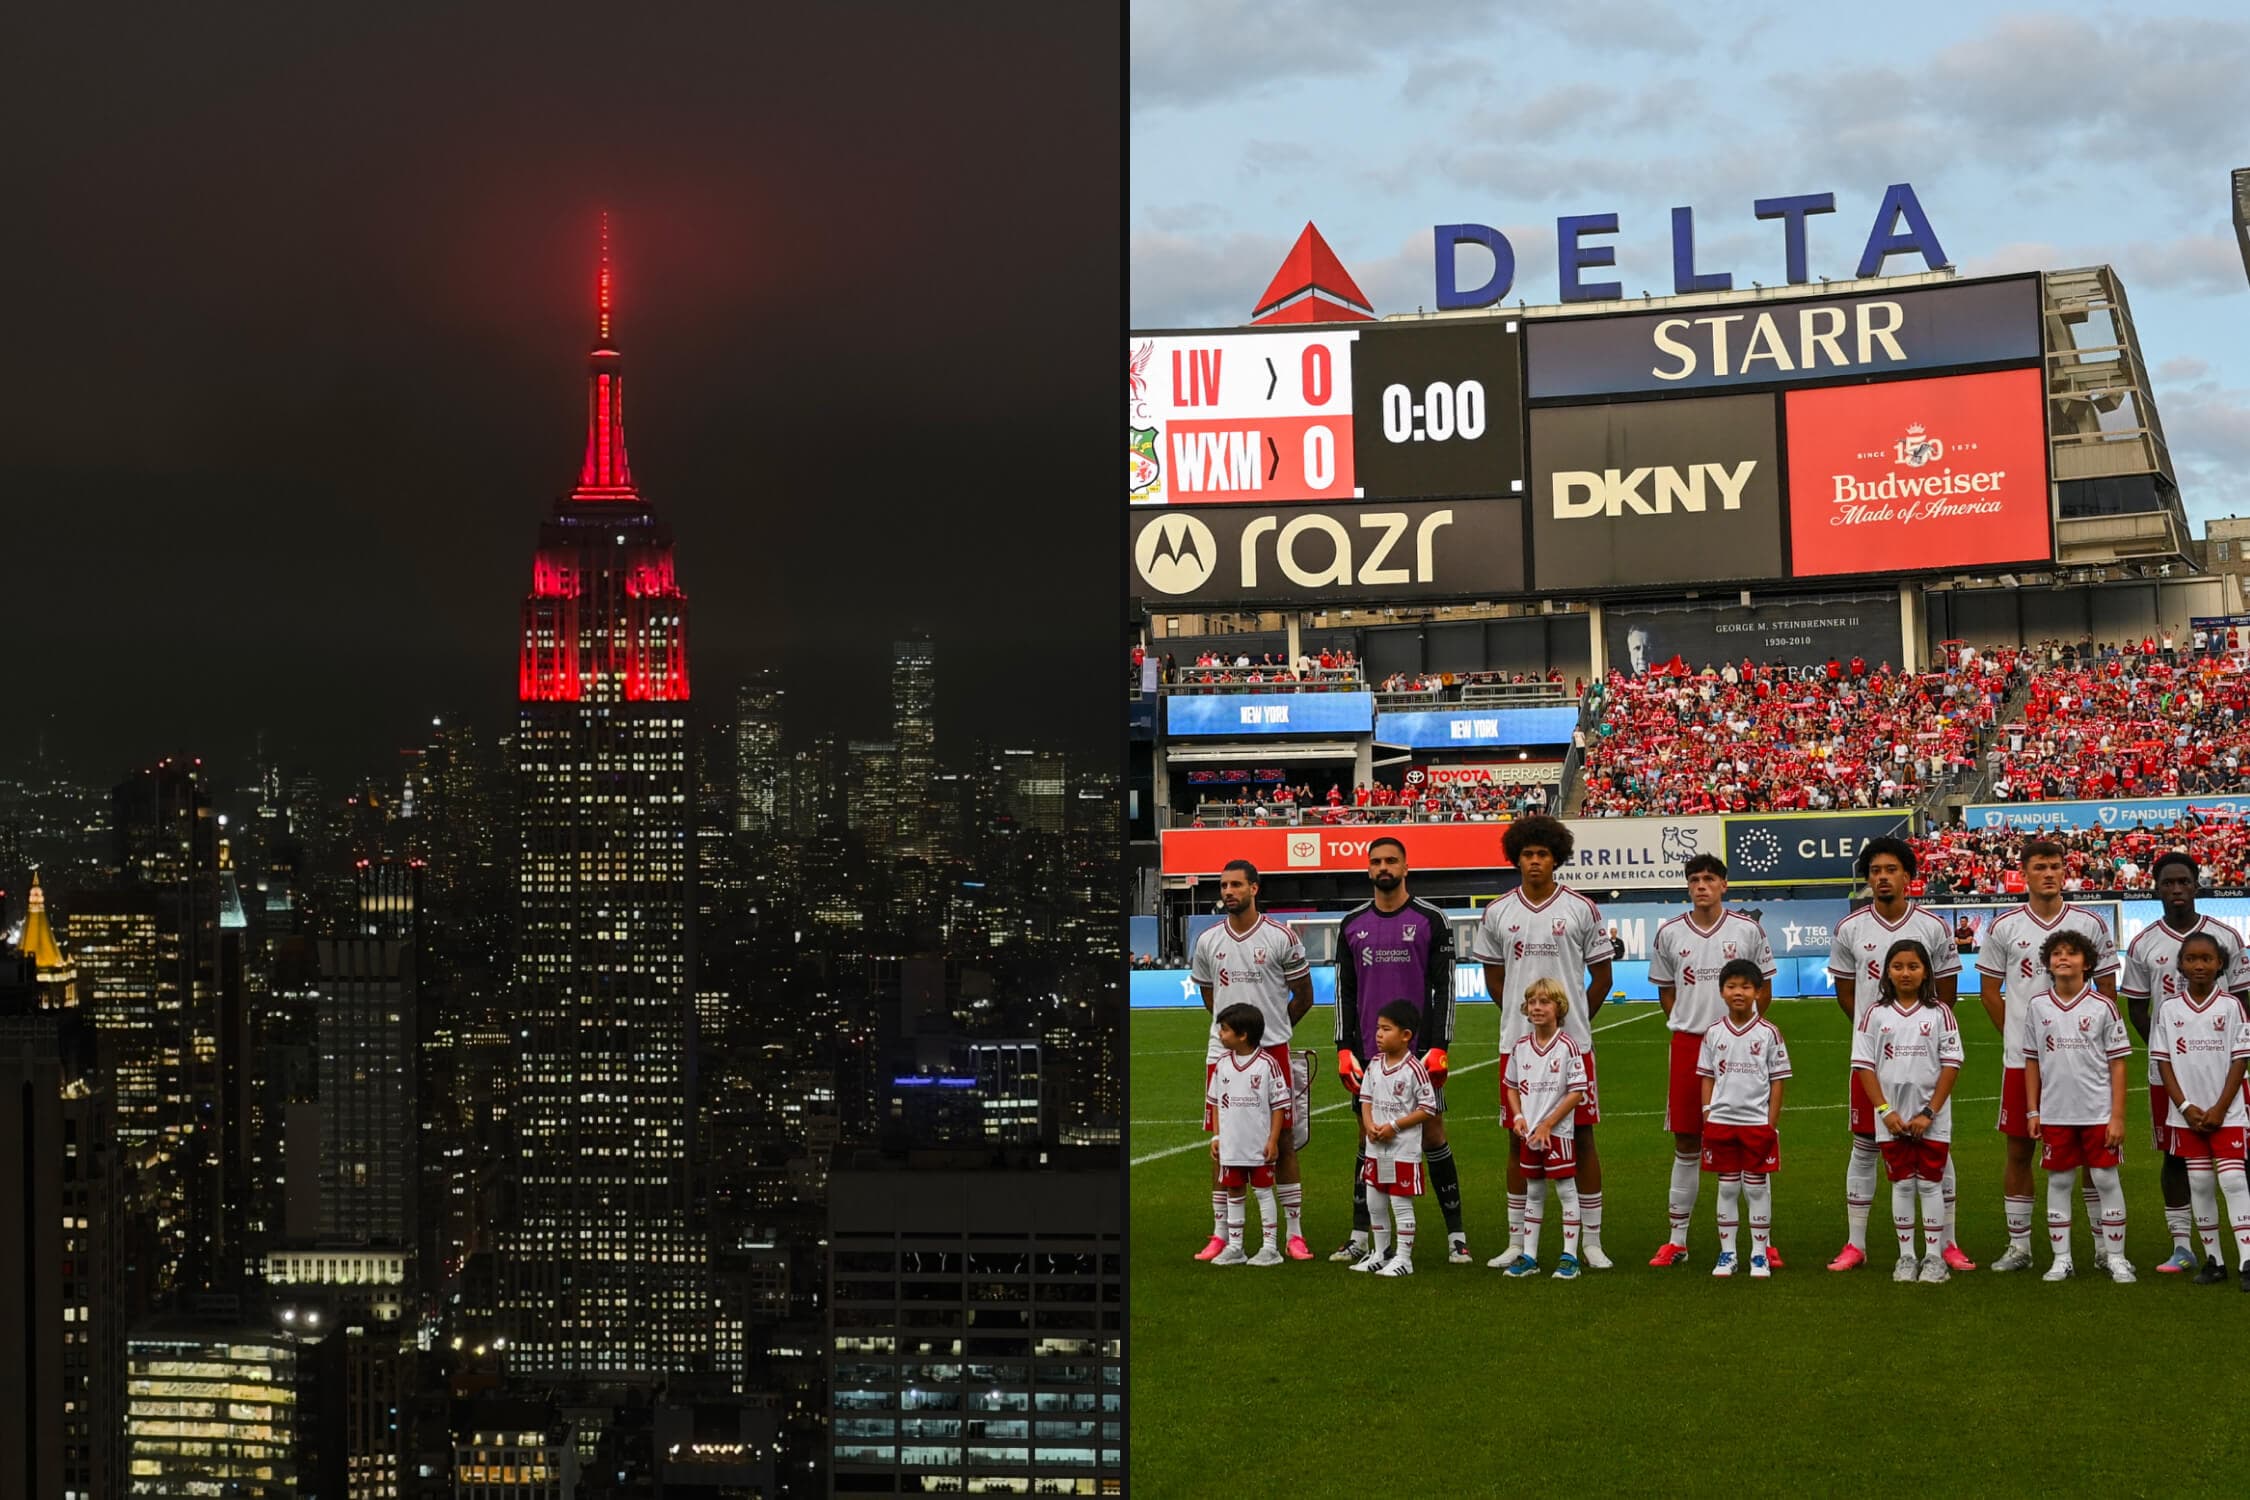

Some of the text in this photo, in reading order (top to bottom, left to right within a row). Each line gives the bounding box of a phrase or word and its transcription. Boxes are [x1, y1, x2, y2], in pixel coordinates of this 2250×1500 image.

[1434, 182, 1949, 311] DELTA
[1652, 300, 1908, 382] STARR
[1172, 344, 1333, 407] LIV 0
[1383, 379, 1486, 443] 0:00
[1172, 425, 1335, 492] WXM 0
[1857, 451, 1886, 460] SINCE
[1552, 459, 1758, 520] DKNY
[1832, 467, 2006, 503] Budweiser
[1830, 497, 2003, 527] Made of America
[1240, 509, 1453, 588] razr
[1715, 617, 1860, 633] GEORGE M. STEINBRENNER III
[1765, 636, 1812, 647] 1930-2010
[1240, 705, 1290, 724] NEW YORK
[1450, 719, 1499, 739] NEW YORK
[1430, 766, 1562, 783] TOYOTA TERRACE
[2007, 812, 2069, 825] FANDUEL
[2121, 807, 2182, 821] FANDUEL
[1585, 870, 1600, 880] OF
[1602, 870, 1656, 879] AMERICA
[2214, 890, 2244, 898] StubHub
[1804, 926, 1828, 936] TEG
[1524, 950, 1560, 958] chartered
[1525, 943, 1558, 951] standard
[1231, 969, 1261, 977] standard
